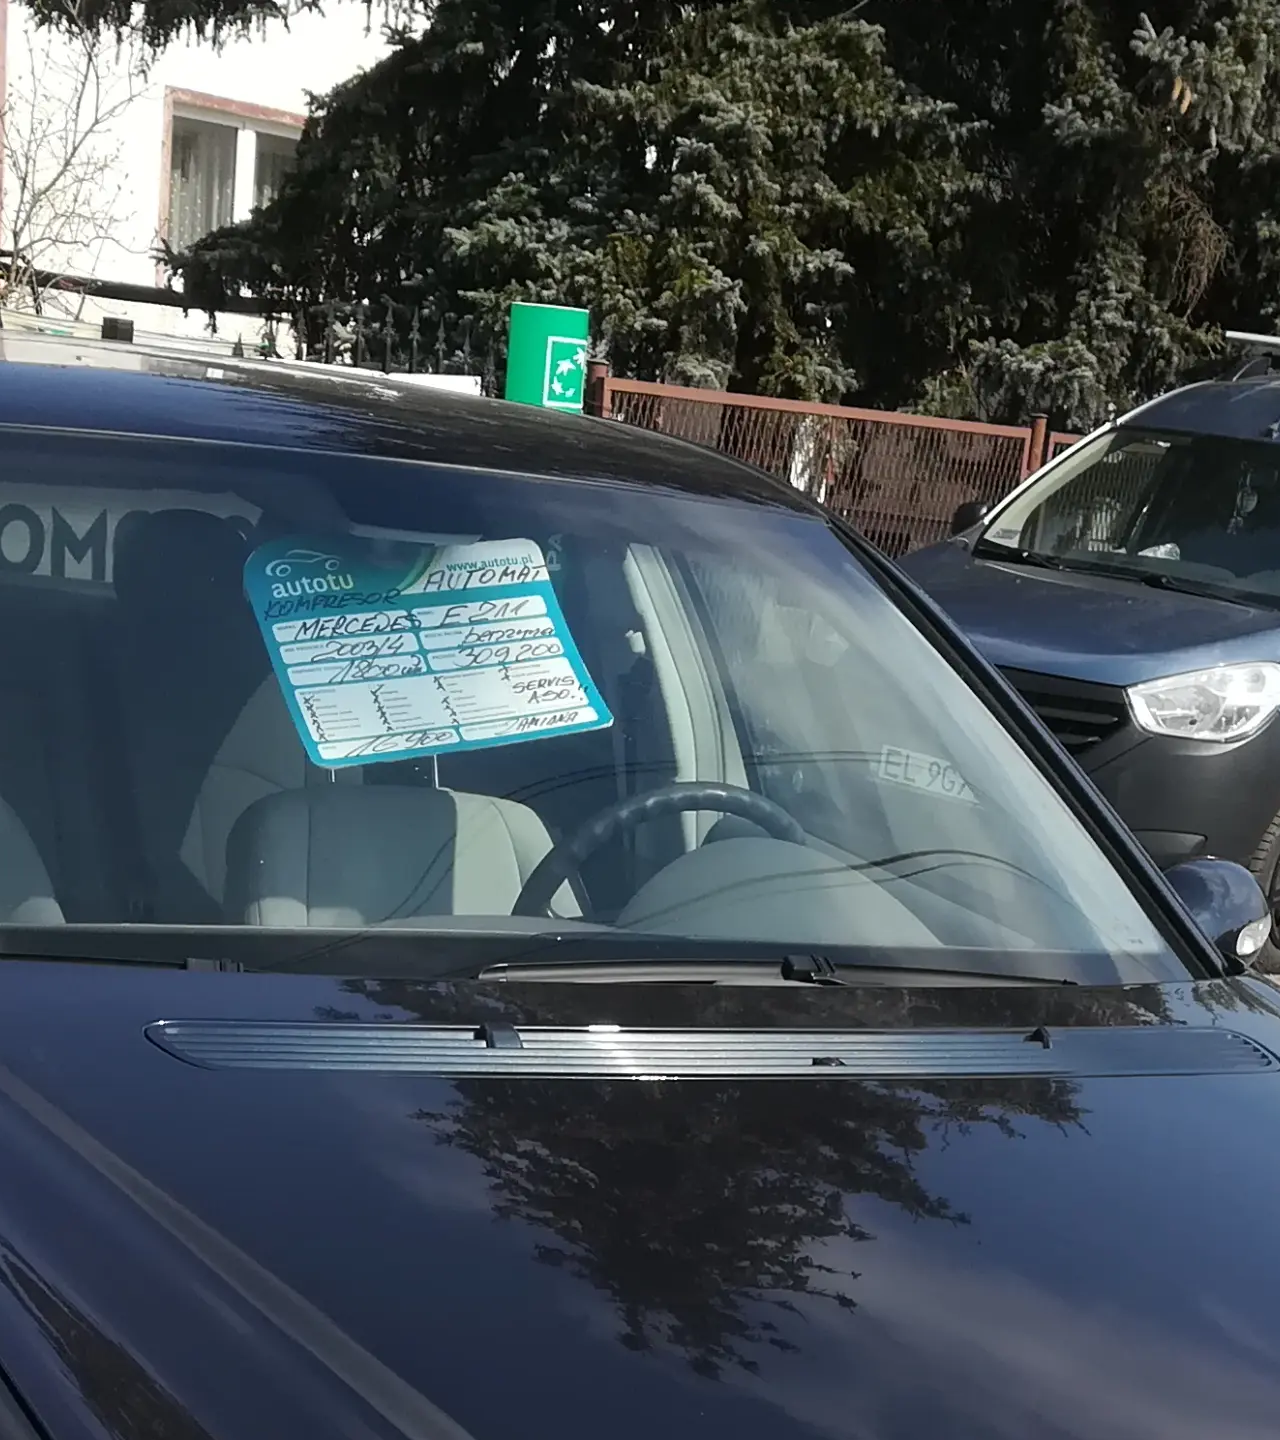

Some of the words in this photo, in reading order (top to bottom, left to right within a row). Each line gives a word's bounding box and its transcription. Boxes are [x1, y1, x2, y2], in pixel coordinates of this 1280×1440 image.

[446, 553, 534, 571] www.autotu.pl
[271, 573, 354, 599] autotu
[423, 564, 548, 592] AUTOMAT
[264, 588, 401, 621] KOMPRESOR
[468, 599, 530, 623] 211
[294, 611, 422, 641] MERCEDES
[512, 676, 575, 694] SERVIS
[884, 748, 916, 783] EL
